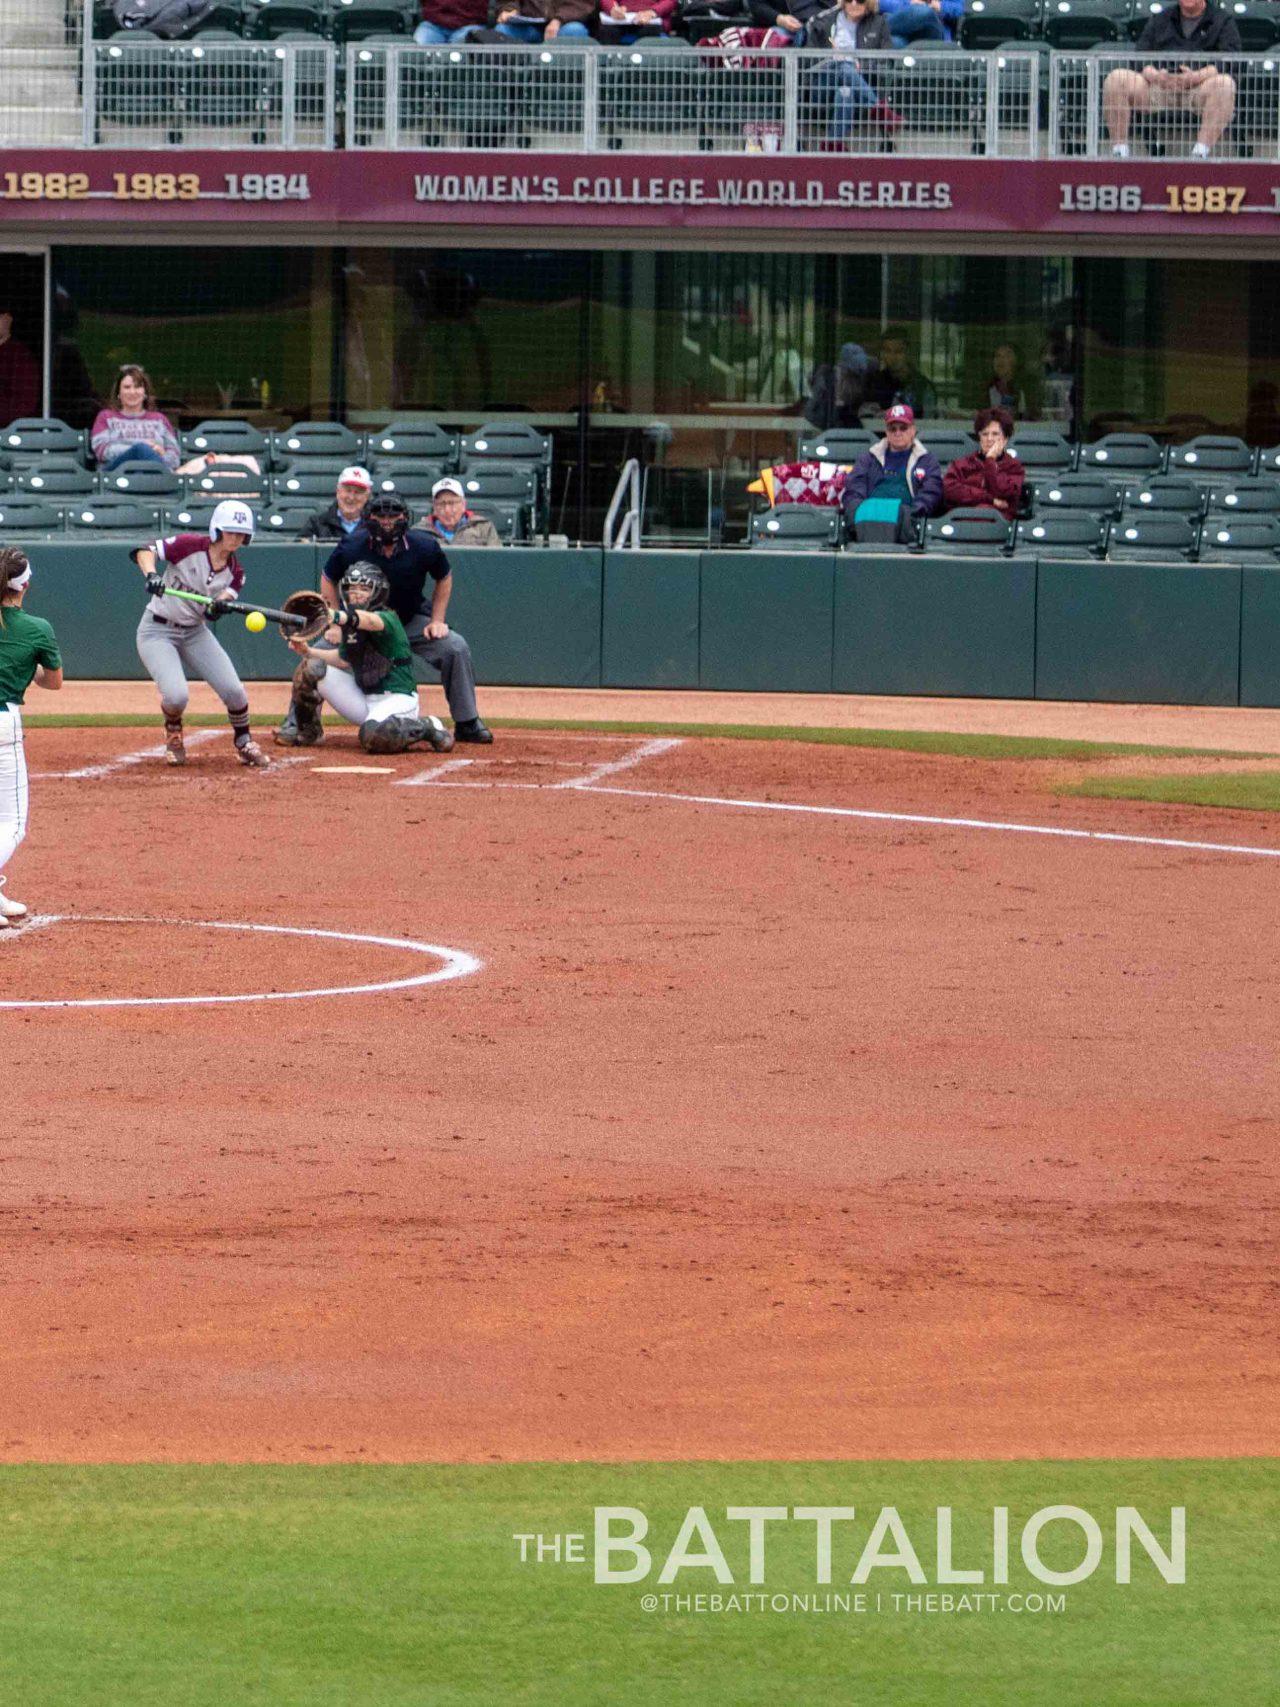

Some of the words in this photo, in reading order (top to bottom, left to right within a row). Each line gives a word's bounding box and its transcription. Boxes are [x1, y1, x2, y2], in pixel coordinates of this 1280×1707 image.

[4, 172, 89, 199] 1982
[113, 172, 200, 199] 1983
[224, 173, 310, 200] 1984
[415, 175, 559, 201] WOMEN'S
[573, 177, 704, 204] COLLEGE
[718, 179, 824, 207] WORLD
[838, 181, 951, 208] SERIES
[1059, 184, 1142, 212] 1986
[1166, 185, 1246, 213] 1987
